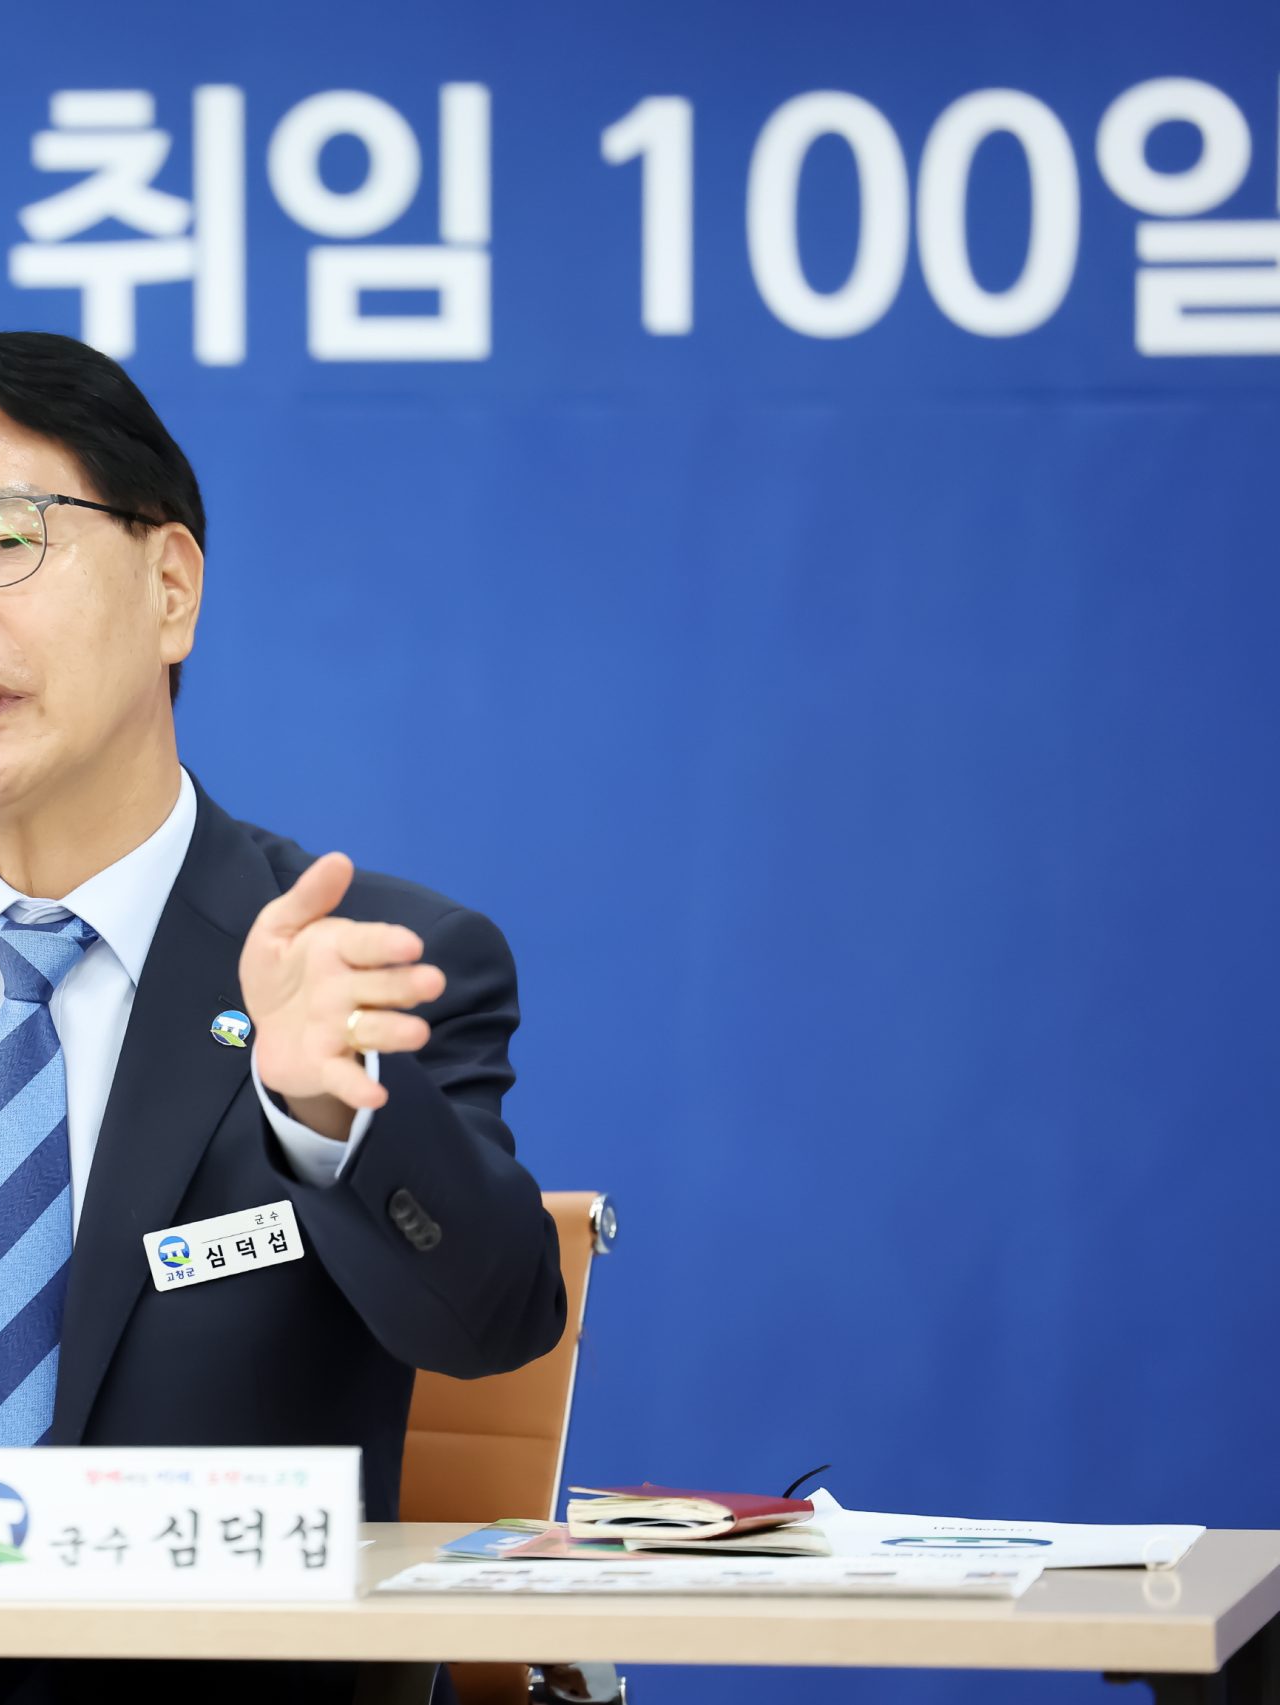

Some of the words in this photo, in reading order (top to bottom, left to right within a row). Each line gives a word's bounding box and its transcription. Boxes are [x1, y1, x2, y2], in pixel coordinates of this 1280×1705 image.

[7, 82, 493, 367] 취임
[599, 75, 1280, 357] 100일
[254, 1211, 279, 1226] 군수
[206, 1229, 289, 1269] 심덕섭
[166, 1267, 196, 1282] 고창군
[50, 1525, 130, 1567] 군수
[153, 1508, 331, 1570] 심덕섭
